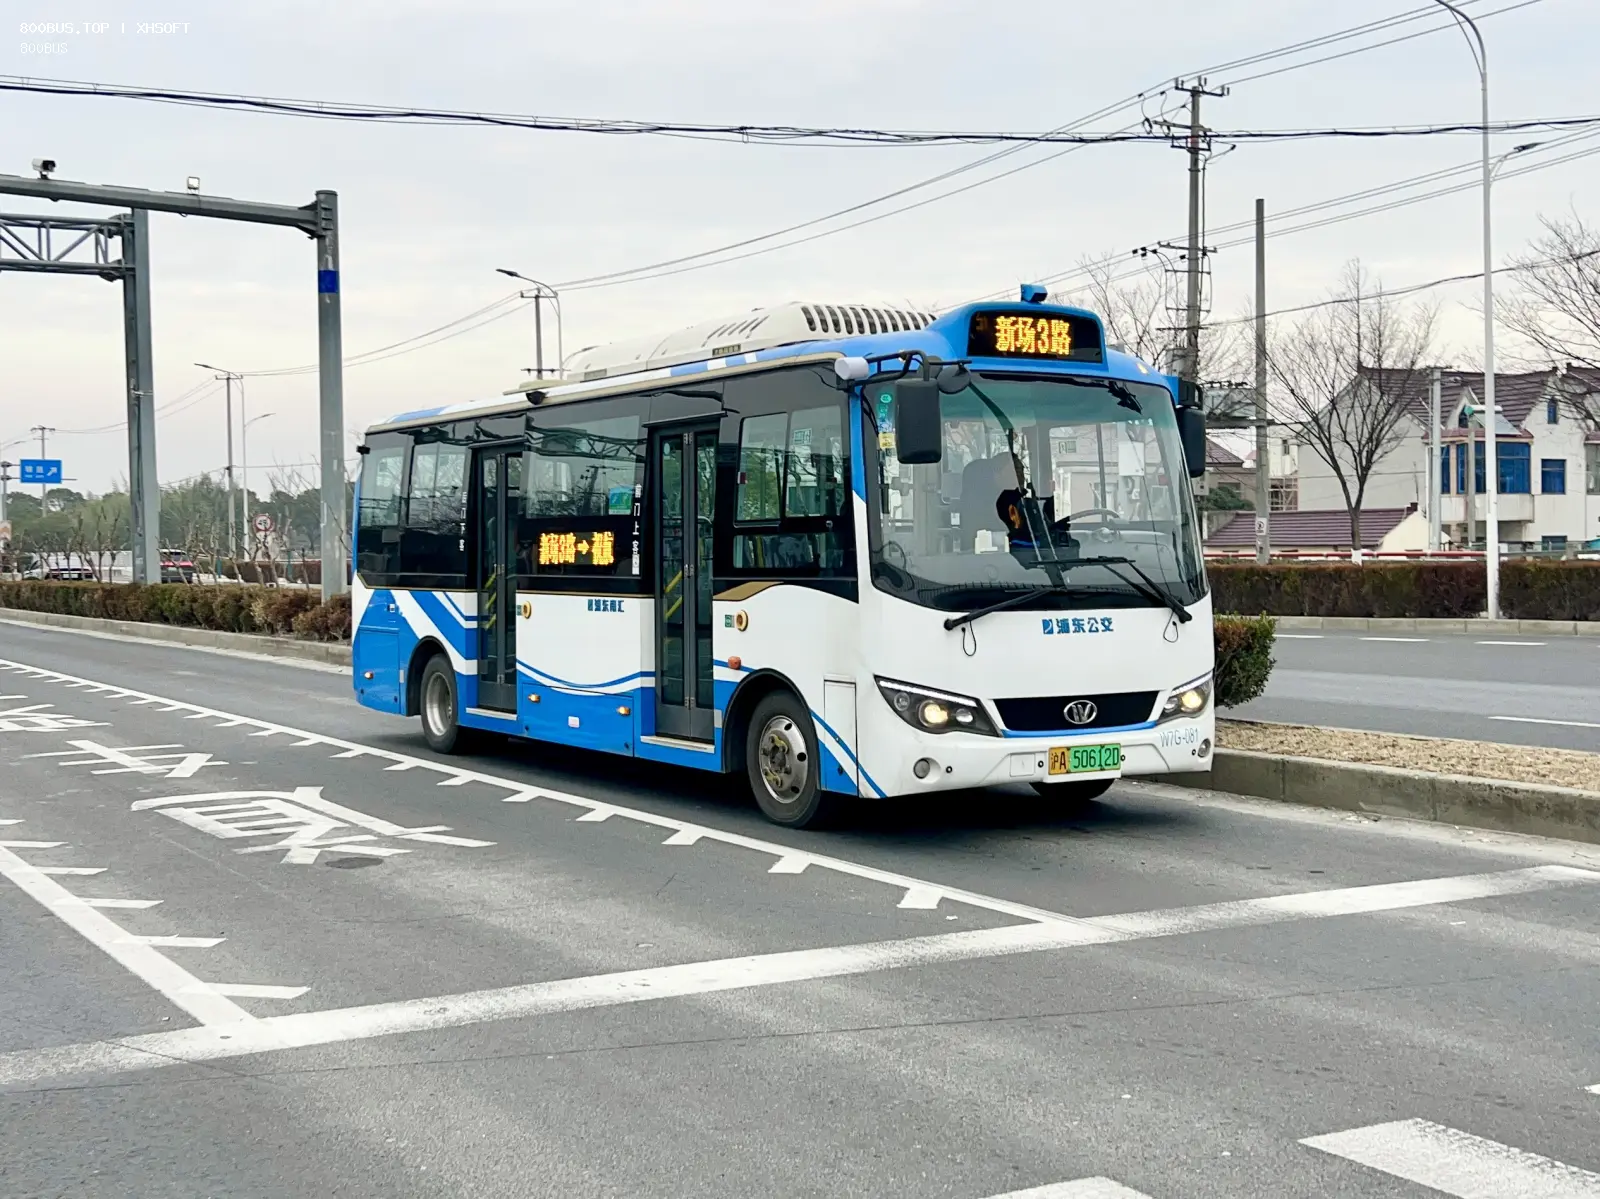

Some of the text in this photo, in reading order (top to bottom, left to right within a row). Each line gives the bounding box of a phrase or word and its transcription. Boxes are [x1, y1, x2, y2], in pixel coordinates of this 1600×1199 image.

[995, 316, 1071, 355] 新场3路
[1056, 616, 1114, 634] 浦东公交
[1160, 728, 1198, 748] W7G-081
